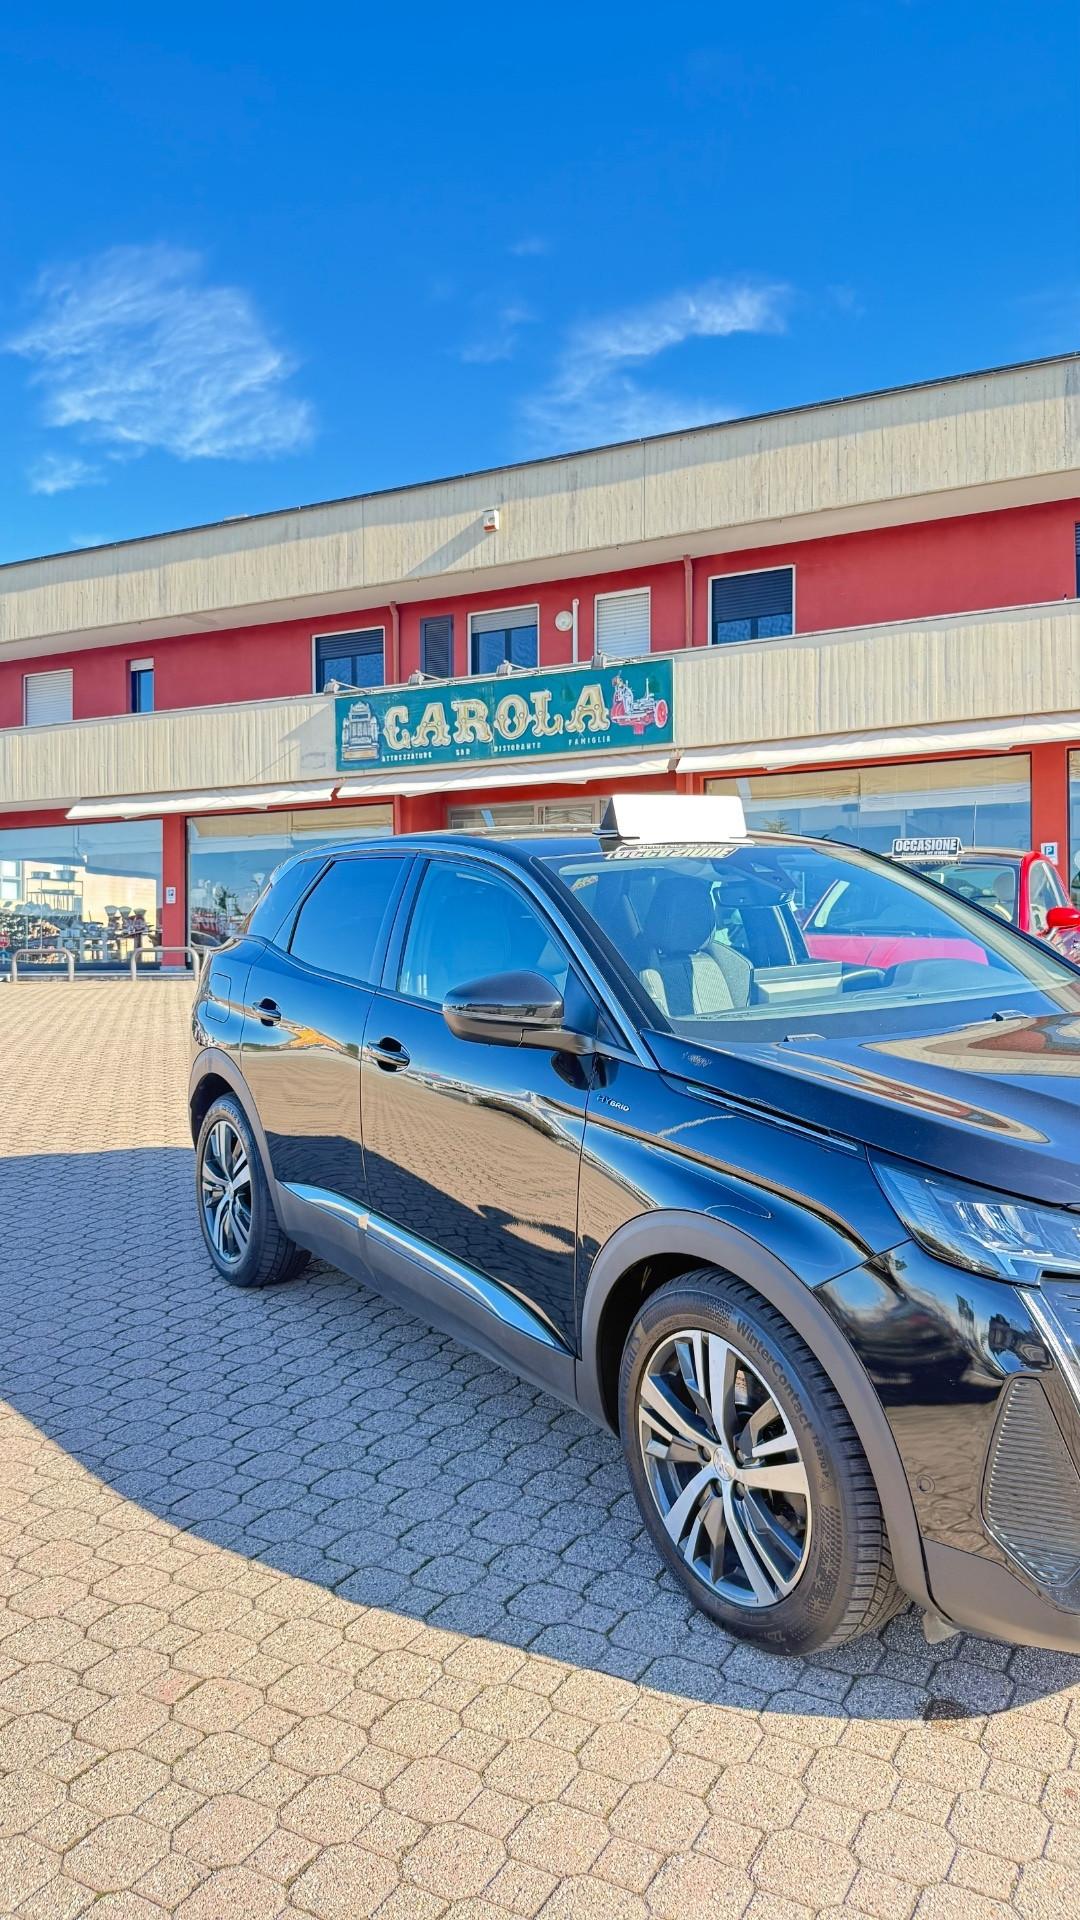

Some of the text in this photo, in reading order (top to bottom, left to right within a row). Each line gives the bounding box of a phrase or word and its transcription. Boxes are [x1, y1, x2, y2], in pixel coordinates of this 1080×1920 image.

[383, 684, 610, 750] CAROLA
[493, 742, 542, 752] RISTORANTE
[895, 839, 957, 852] OCCASIONE
[596, 1094, 631, 1112] HYBRID
[736, 1317, 813, 1432] WinterContact
